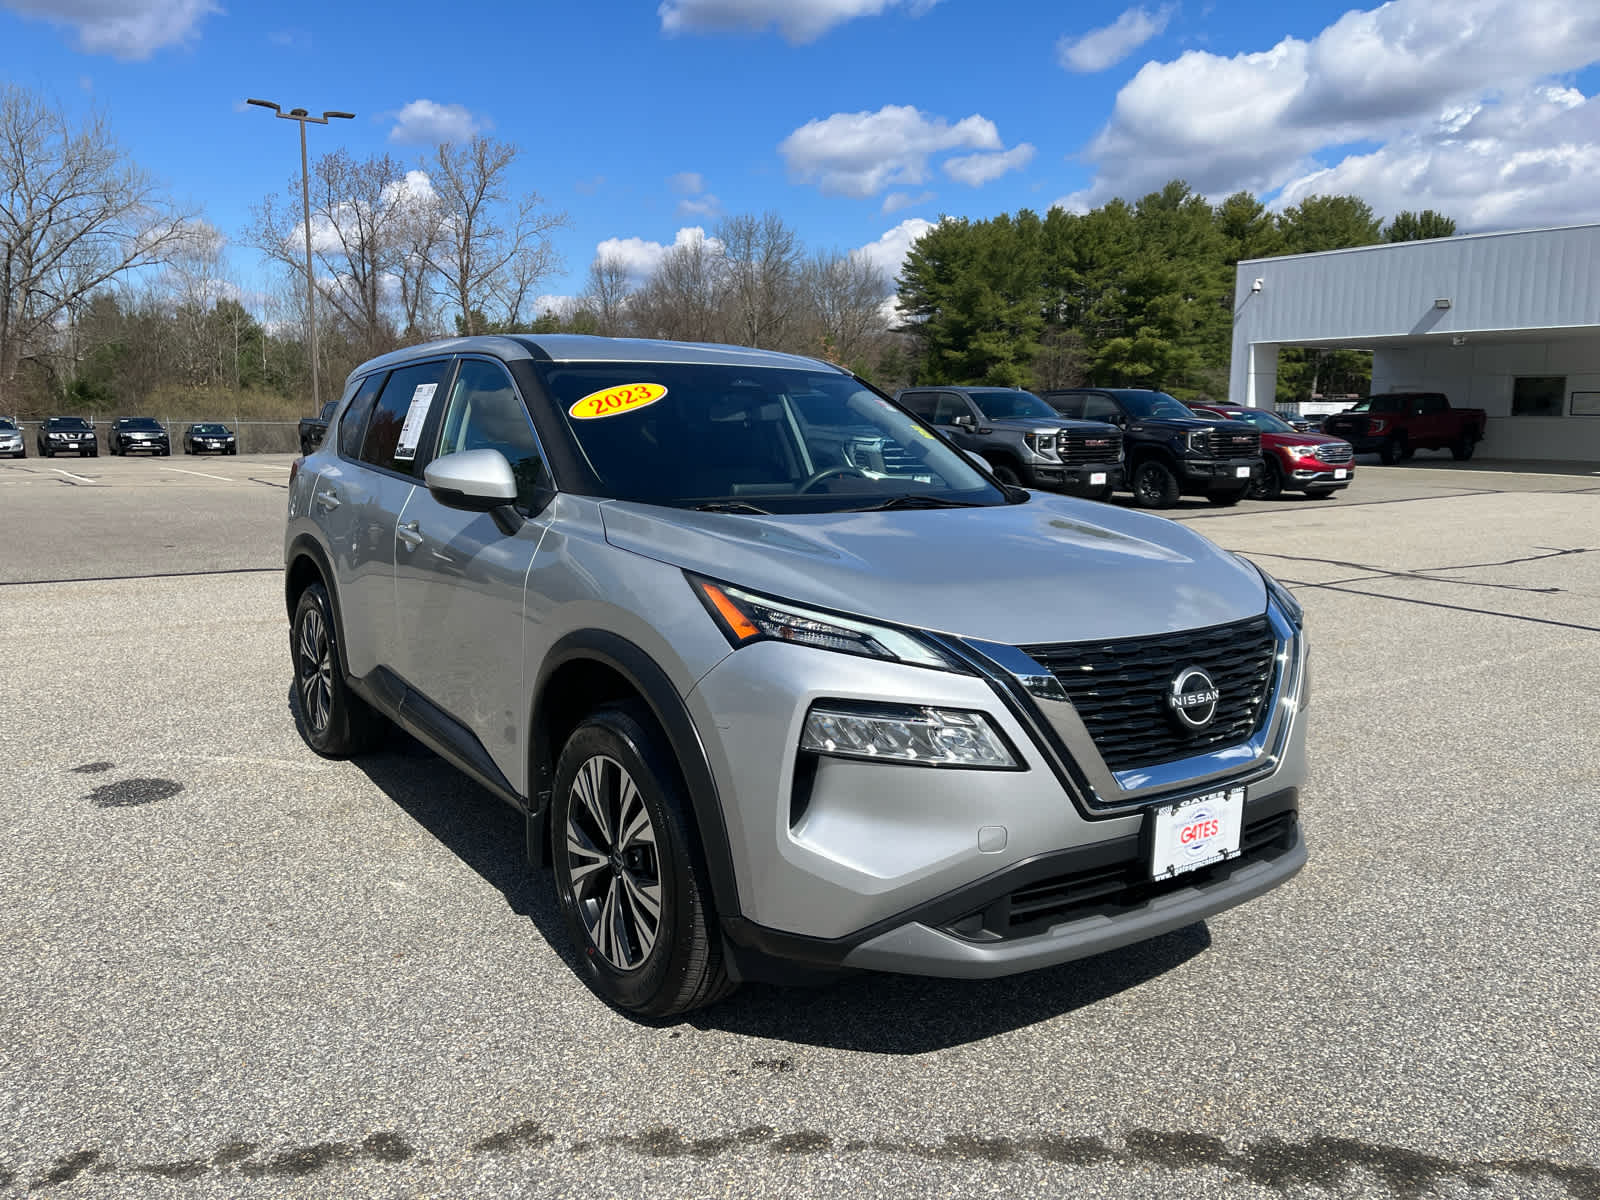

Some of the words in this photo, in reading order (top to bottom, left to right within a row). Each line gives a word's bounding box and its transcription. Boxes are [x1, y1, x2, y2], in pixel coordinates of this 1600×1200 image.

[589, 386, 652, 415] 2023
[1172, 689, 1219, 707] NISSAN
[1180, 819, 1219, 844] GATES
